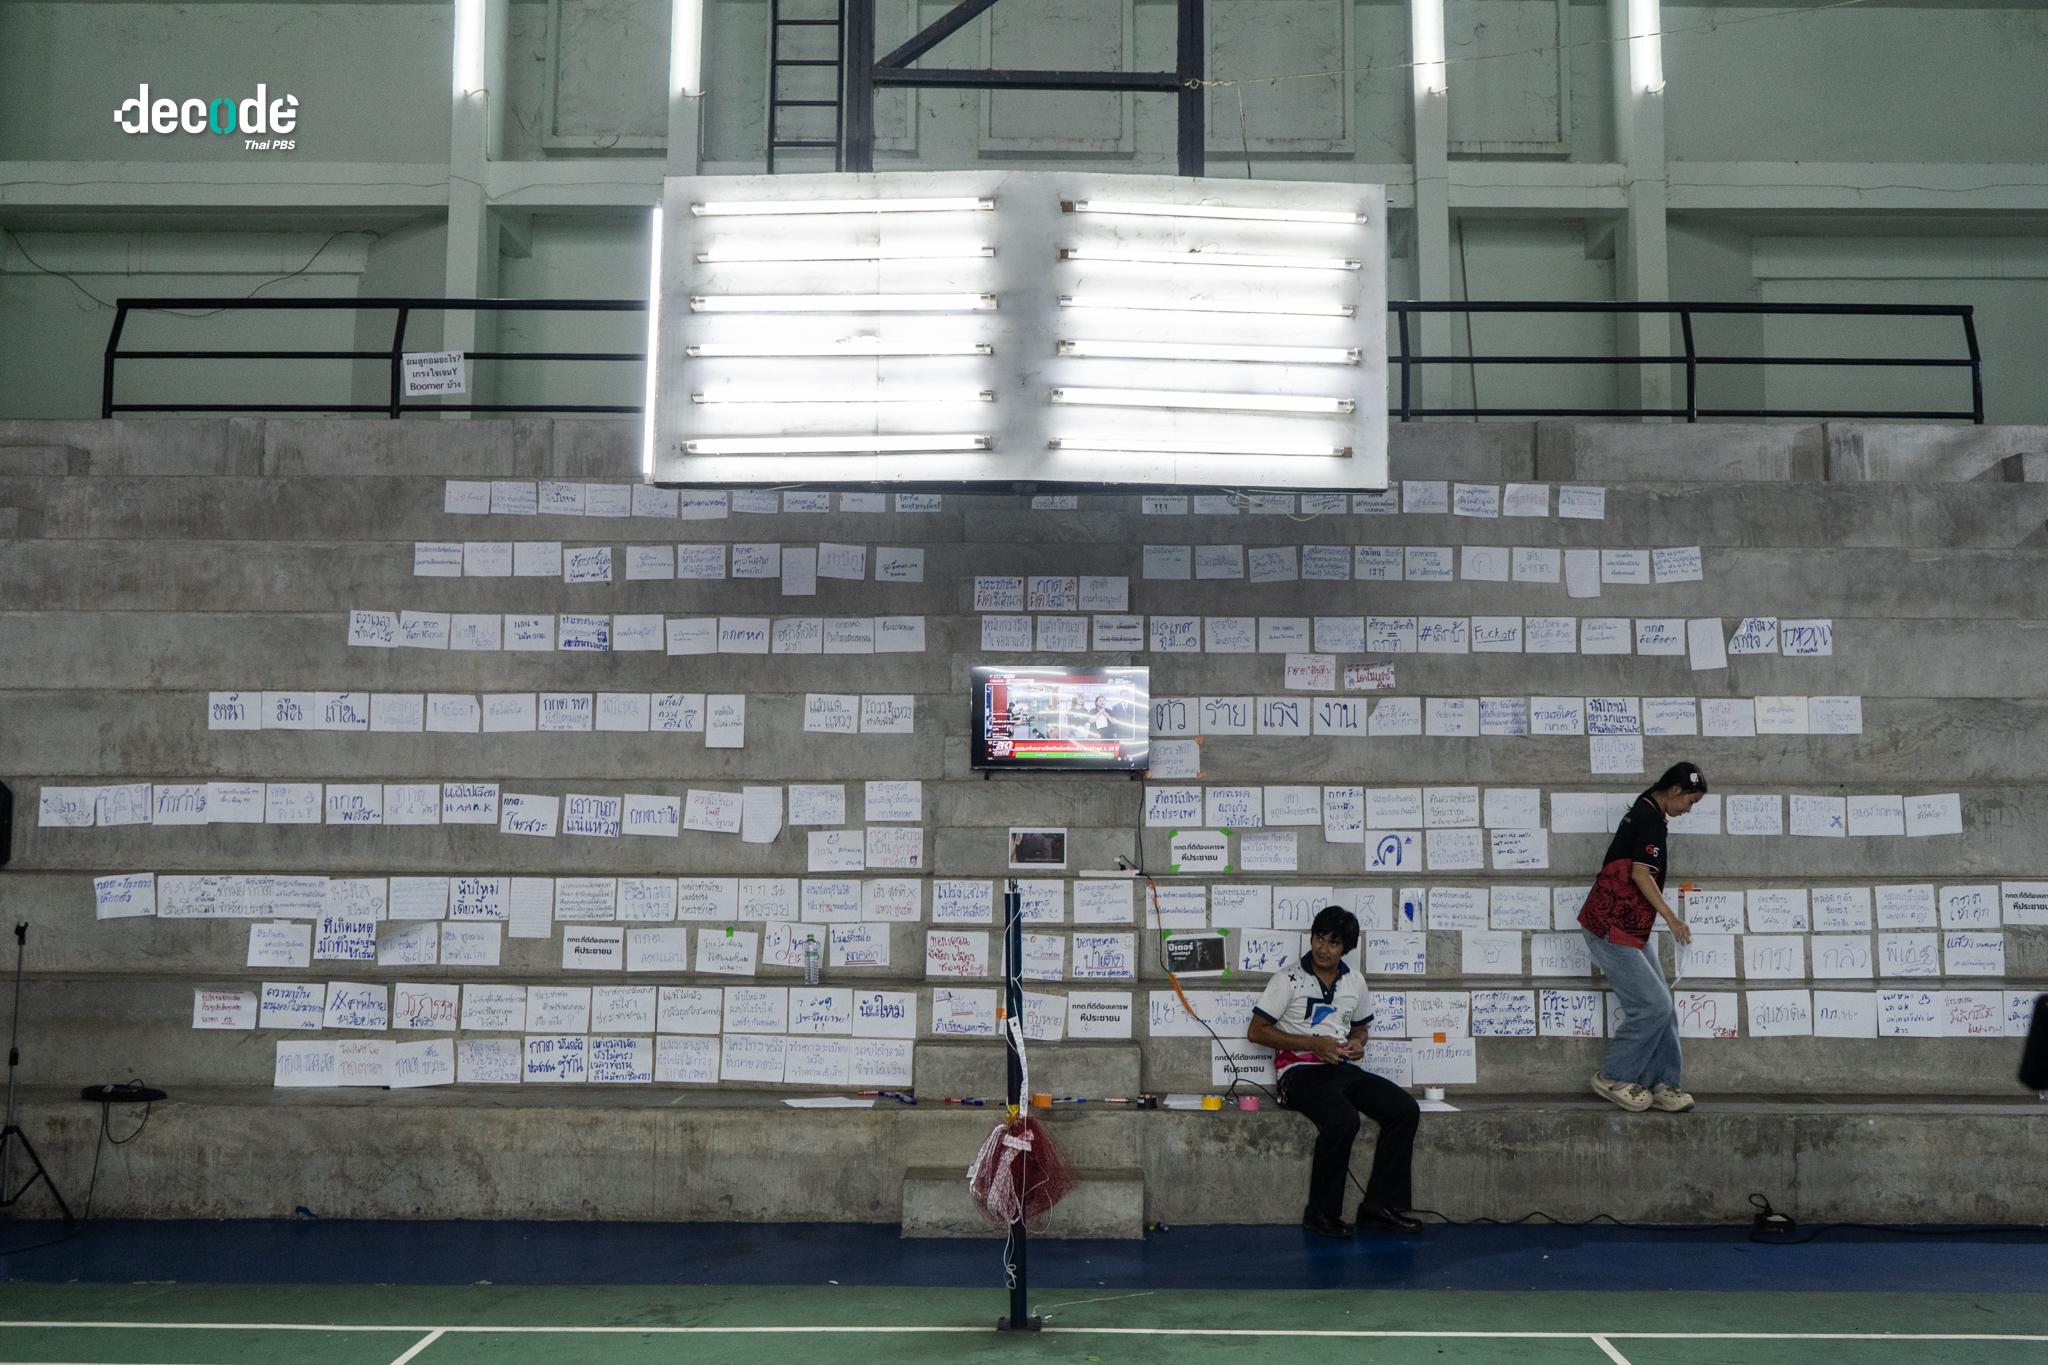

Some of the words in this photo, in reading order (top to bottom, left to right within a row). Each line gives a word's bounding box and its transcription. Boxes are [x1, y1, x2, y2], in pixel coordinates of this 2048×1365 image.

[410, 382, 443, 391] Boomer
[1156, 699, 1186, 731] ตัว
[1205, 698, 1246, 727] ร้าย
[1263, 702, 1299, 727] แรง
[1320, 702, 1358, 729] งาน
